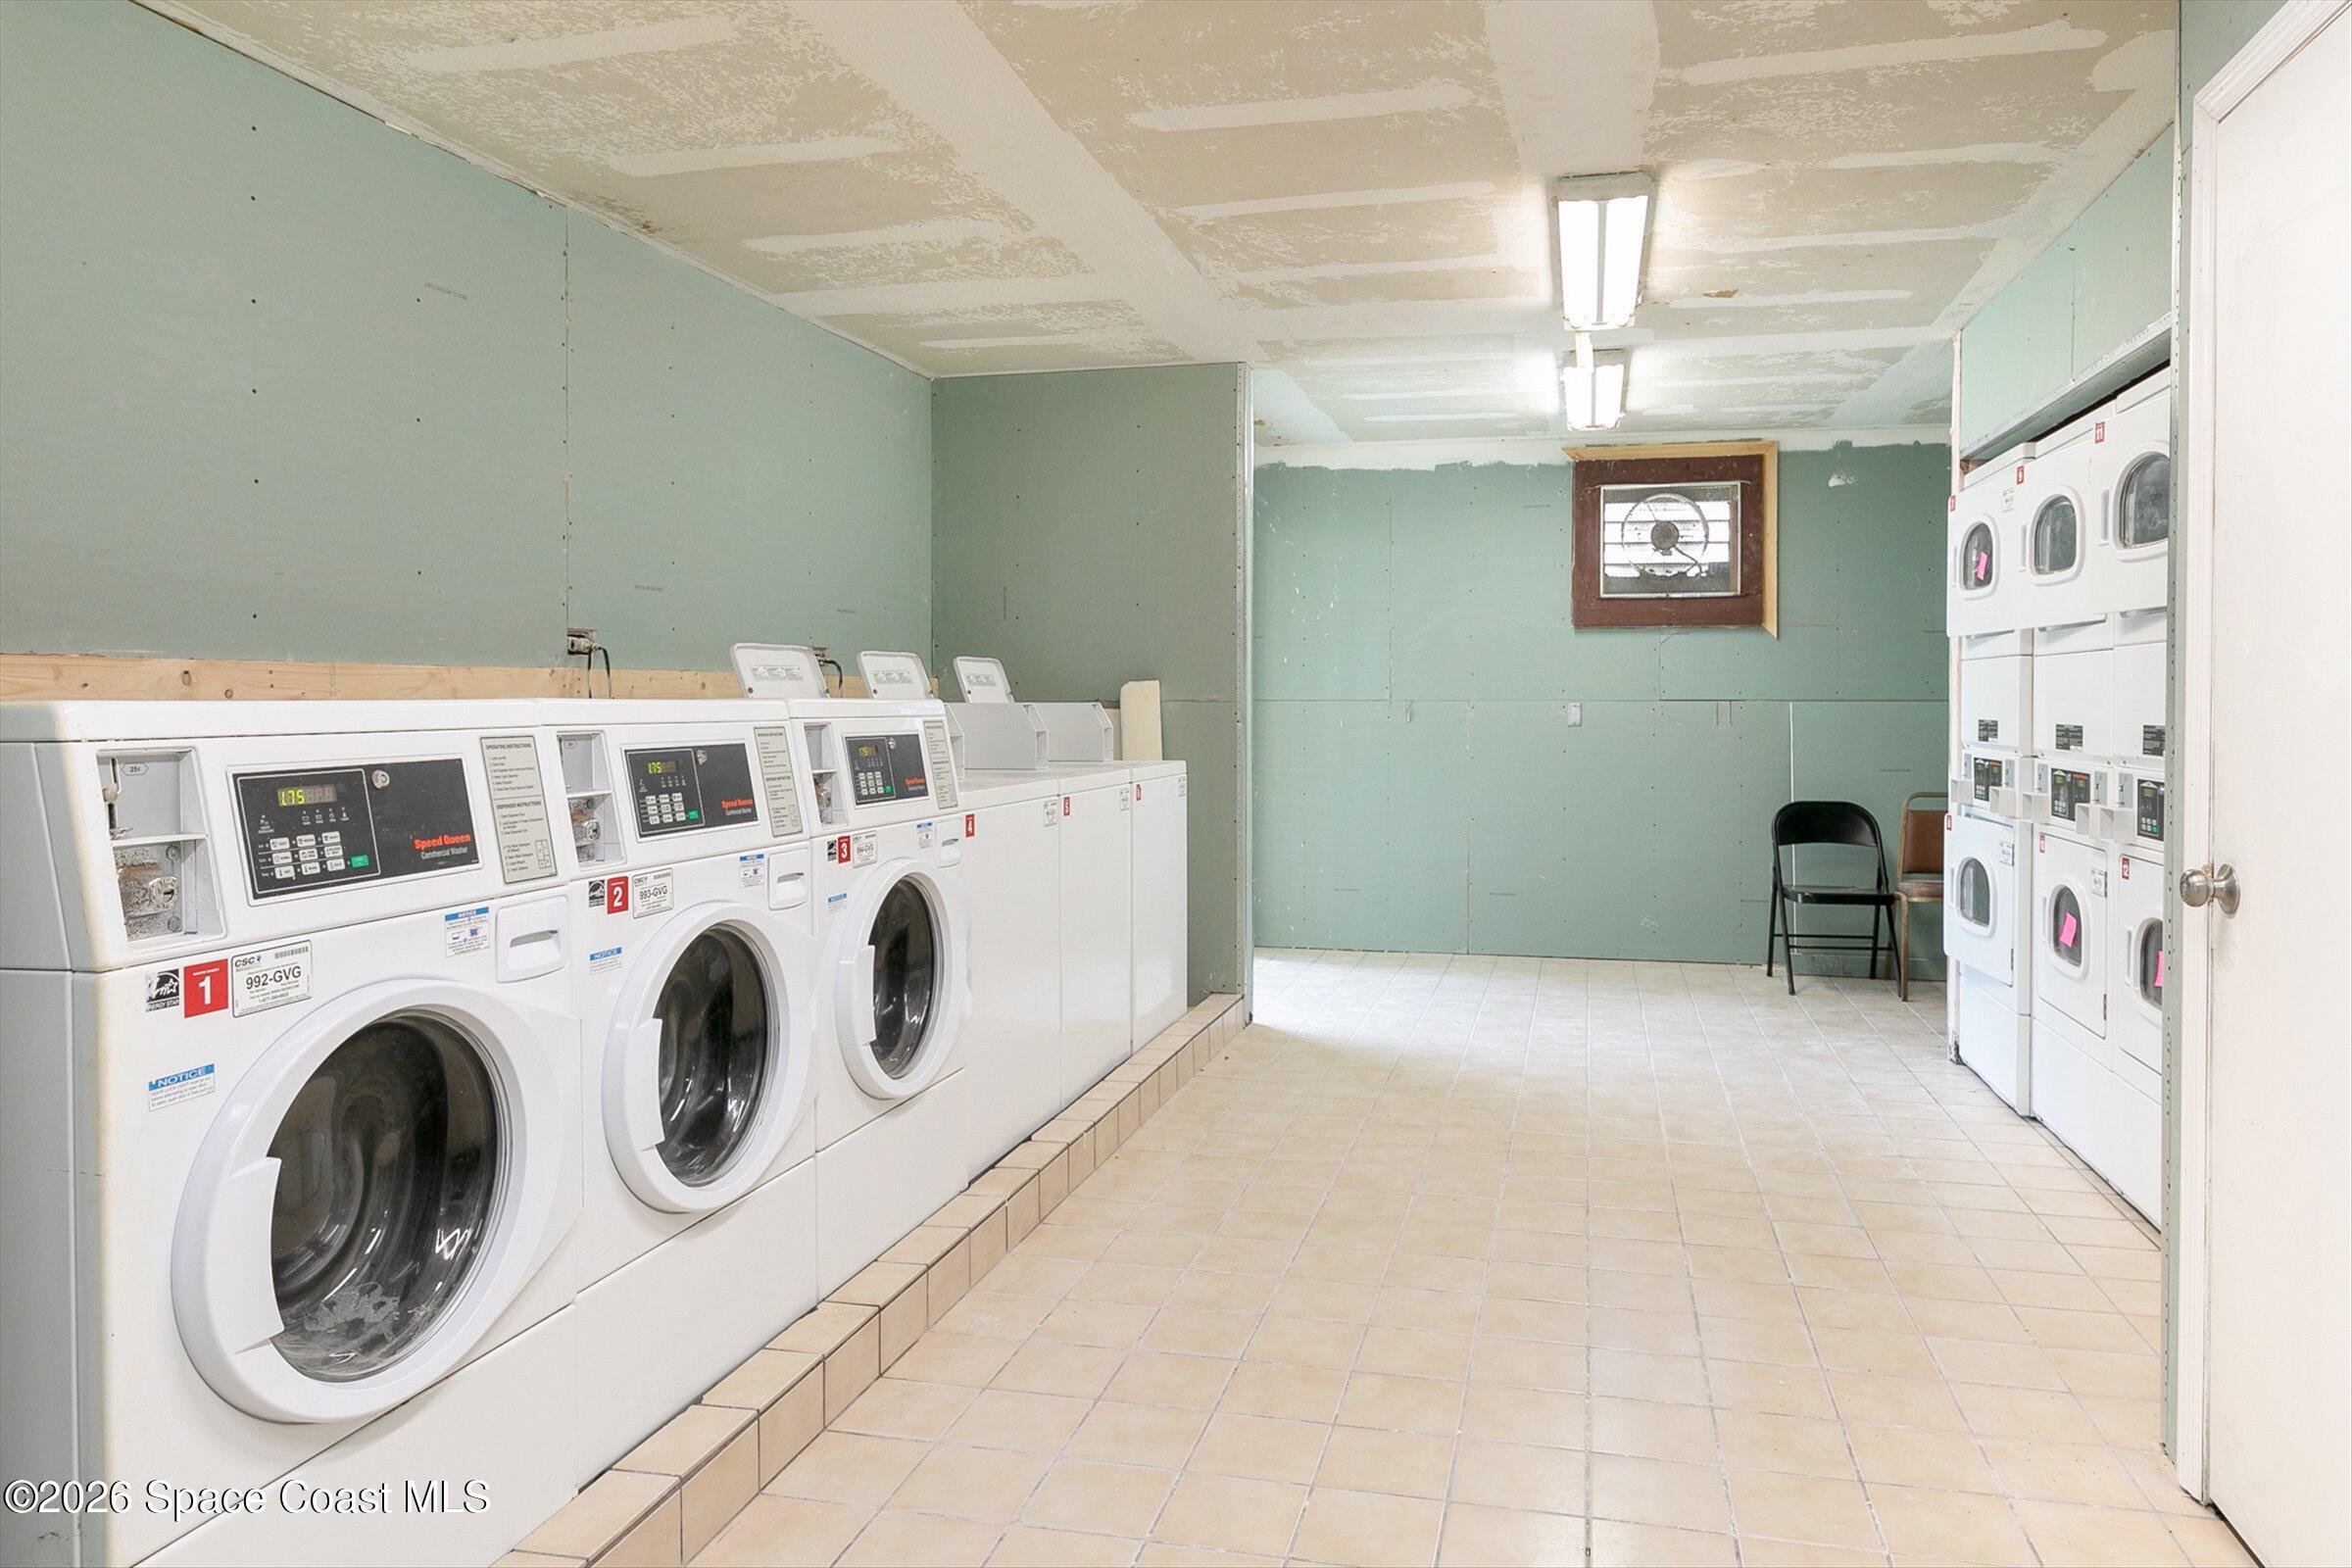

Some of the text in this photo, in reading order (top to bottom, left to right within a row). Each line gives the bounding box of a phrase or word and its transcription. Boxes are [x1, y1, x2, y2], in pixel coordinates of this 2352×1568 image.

[720, 800, 737, 809] Speed
[414, 833, 470, 851] Speed Queen
[841, 843, 848, 858] 3
[420, 846, 468, 859] Commercial Washer
[612, 886, 623, 907] 2
[639, 885, 668, 901] 993-GVG
[234, 956, 256, 968] CSC
[246, 965, 302, 990] 992-GVG
[198, 975, 212, 1005] 1
[158, 1067, 206, 1088] NOTICE
